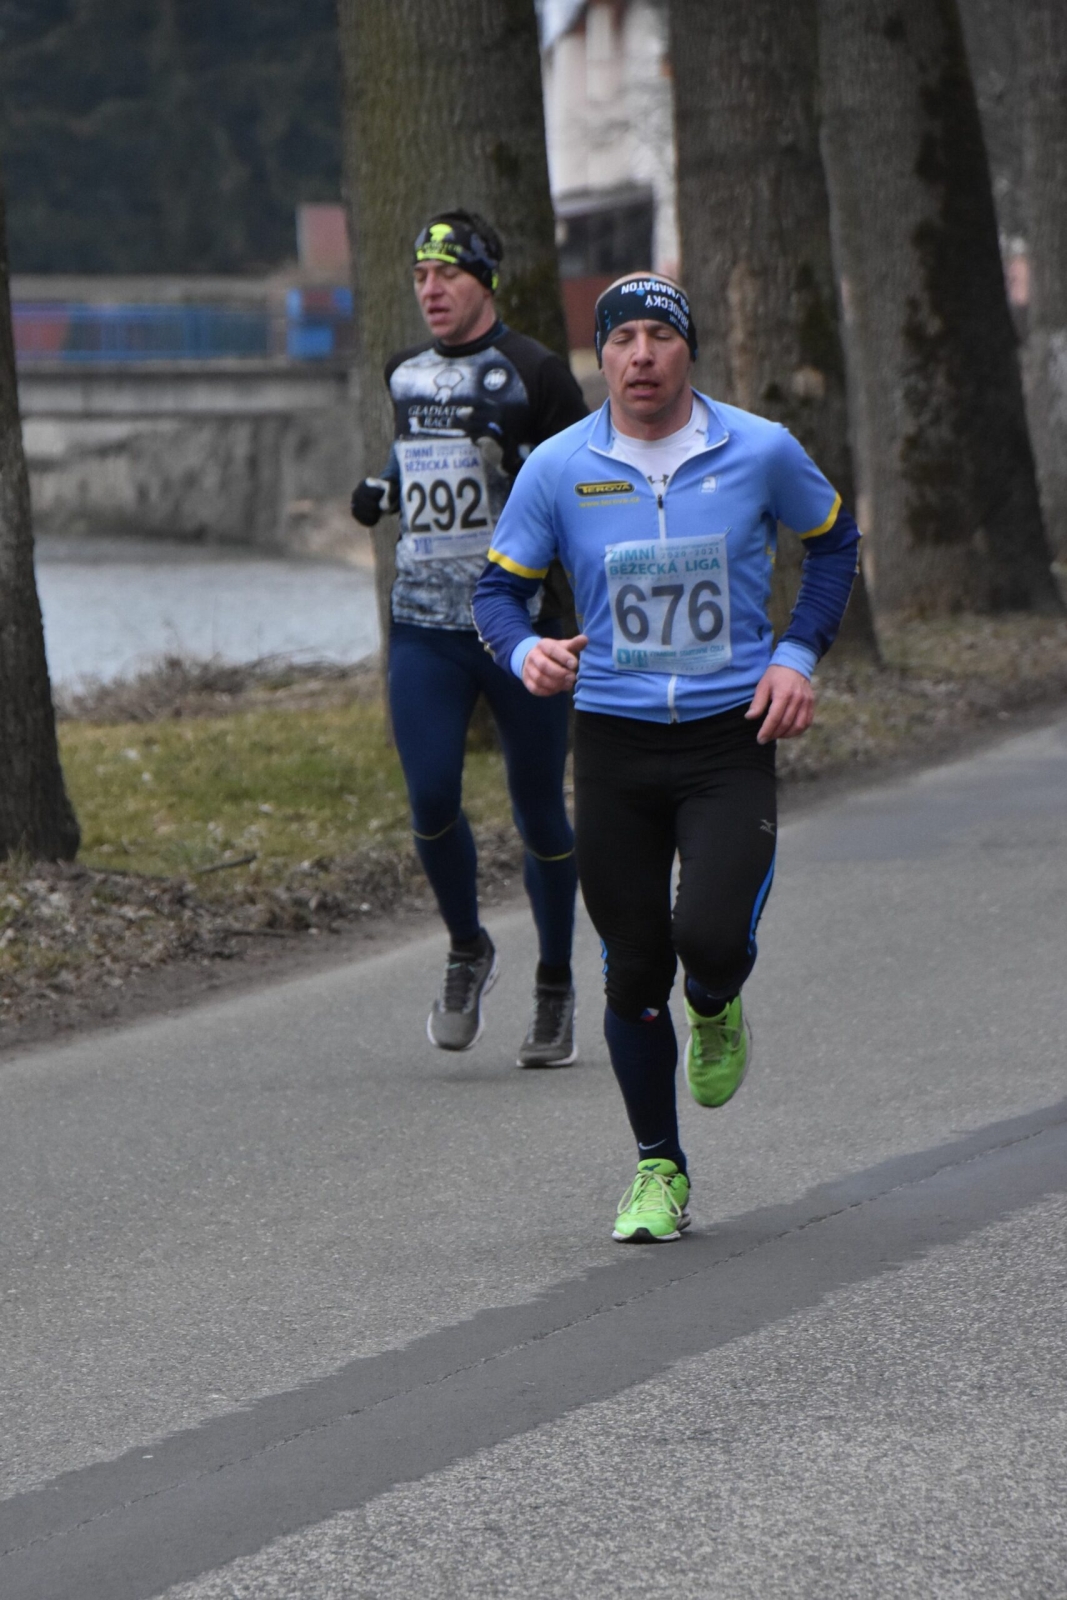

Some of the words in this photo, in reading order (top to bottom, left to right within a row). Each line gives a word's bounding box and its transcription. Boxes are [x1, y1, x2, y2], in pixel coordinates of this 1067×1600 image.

[408, 405, 466, 416] GLADIAT
[453, 457, 479, 469] LIGA
[578, 482, 631, 494] TEROVA
[406, 478, 488, 532] 292
[609, 545, 656, 562] ZIMNÍ
[609, 559, 678, 576] BĚŽECKÁ
[684, 557, 721, 572] LIGA
[614, 580, 724, 646] 676
